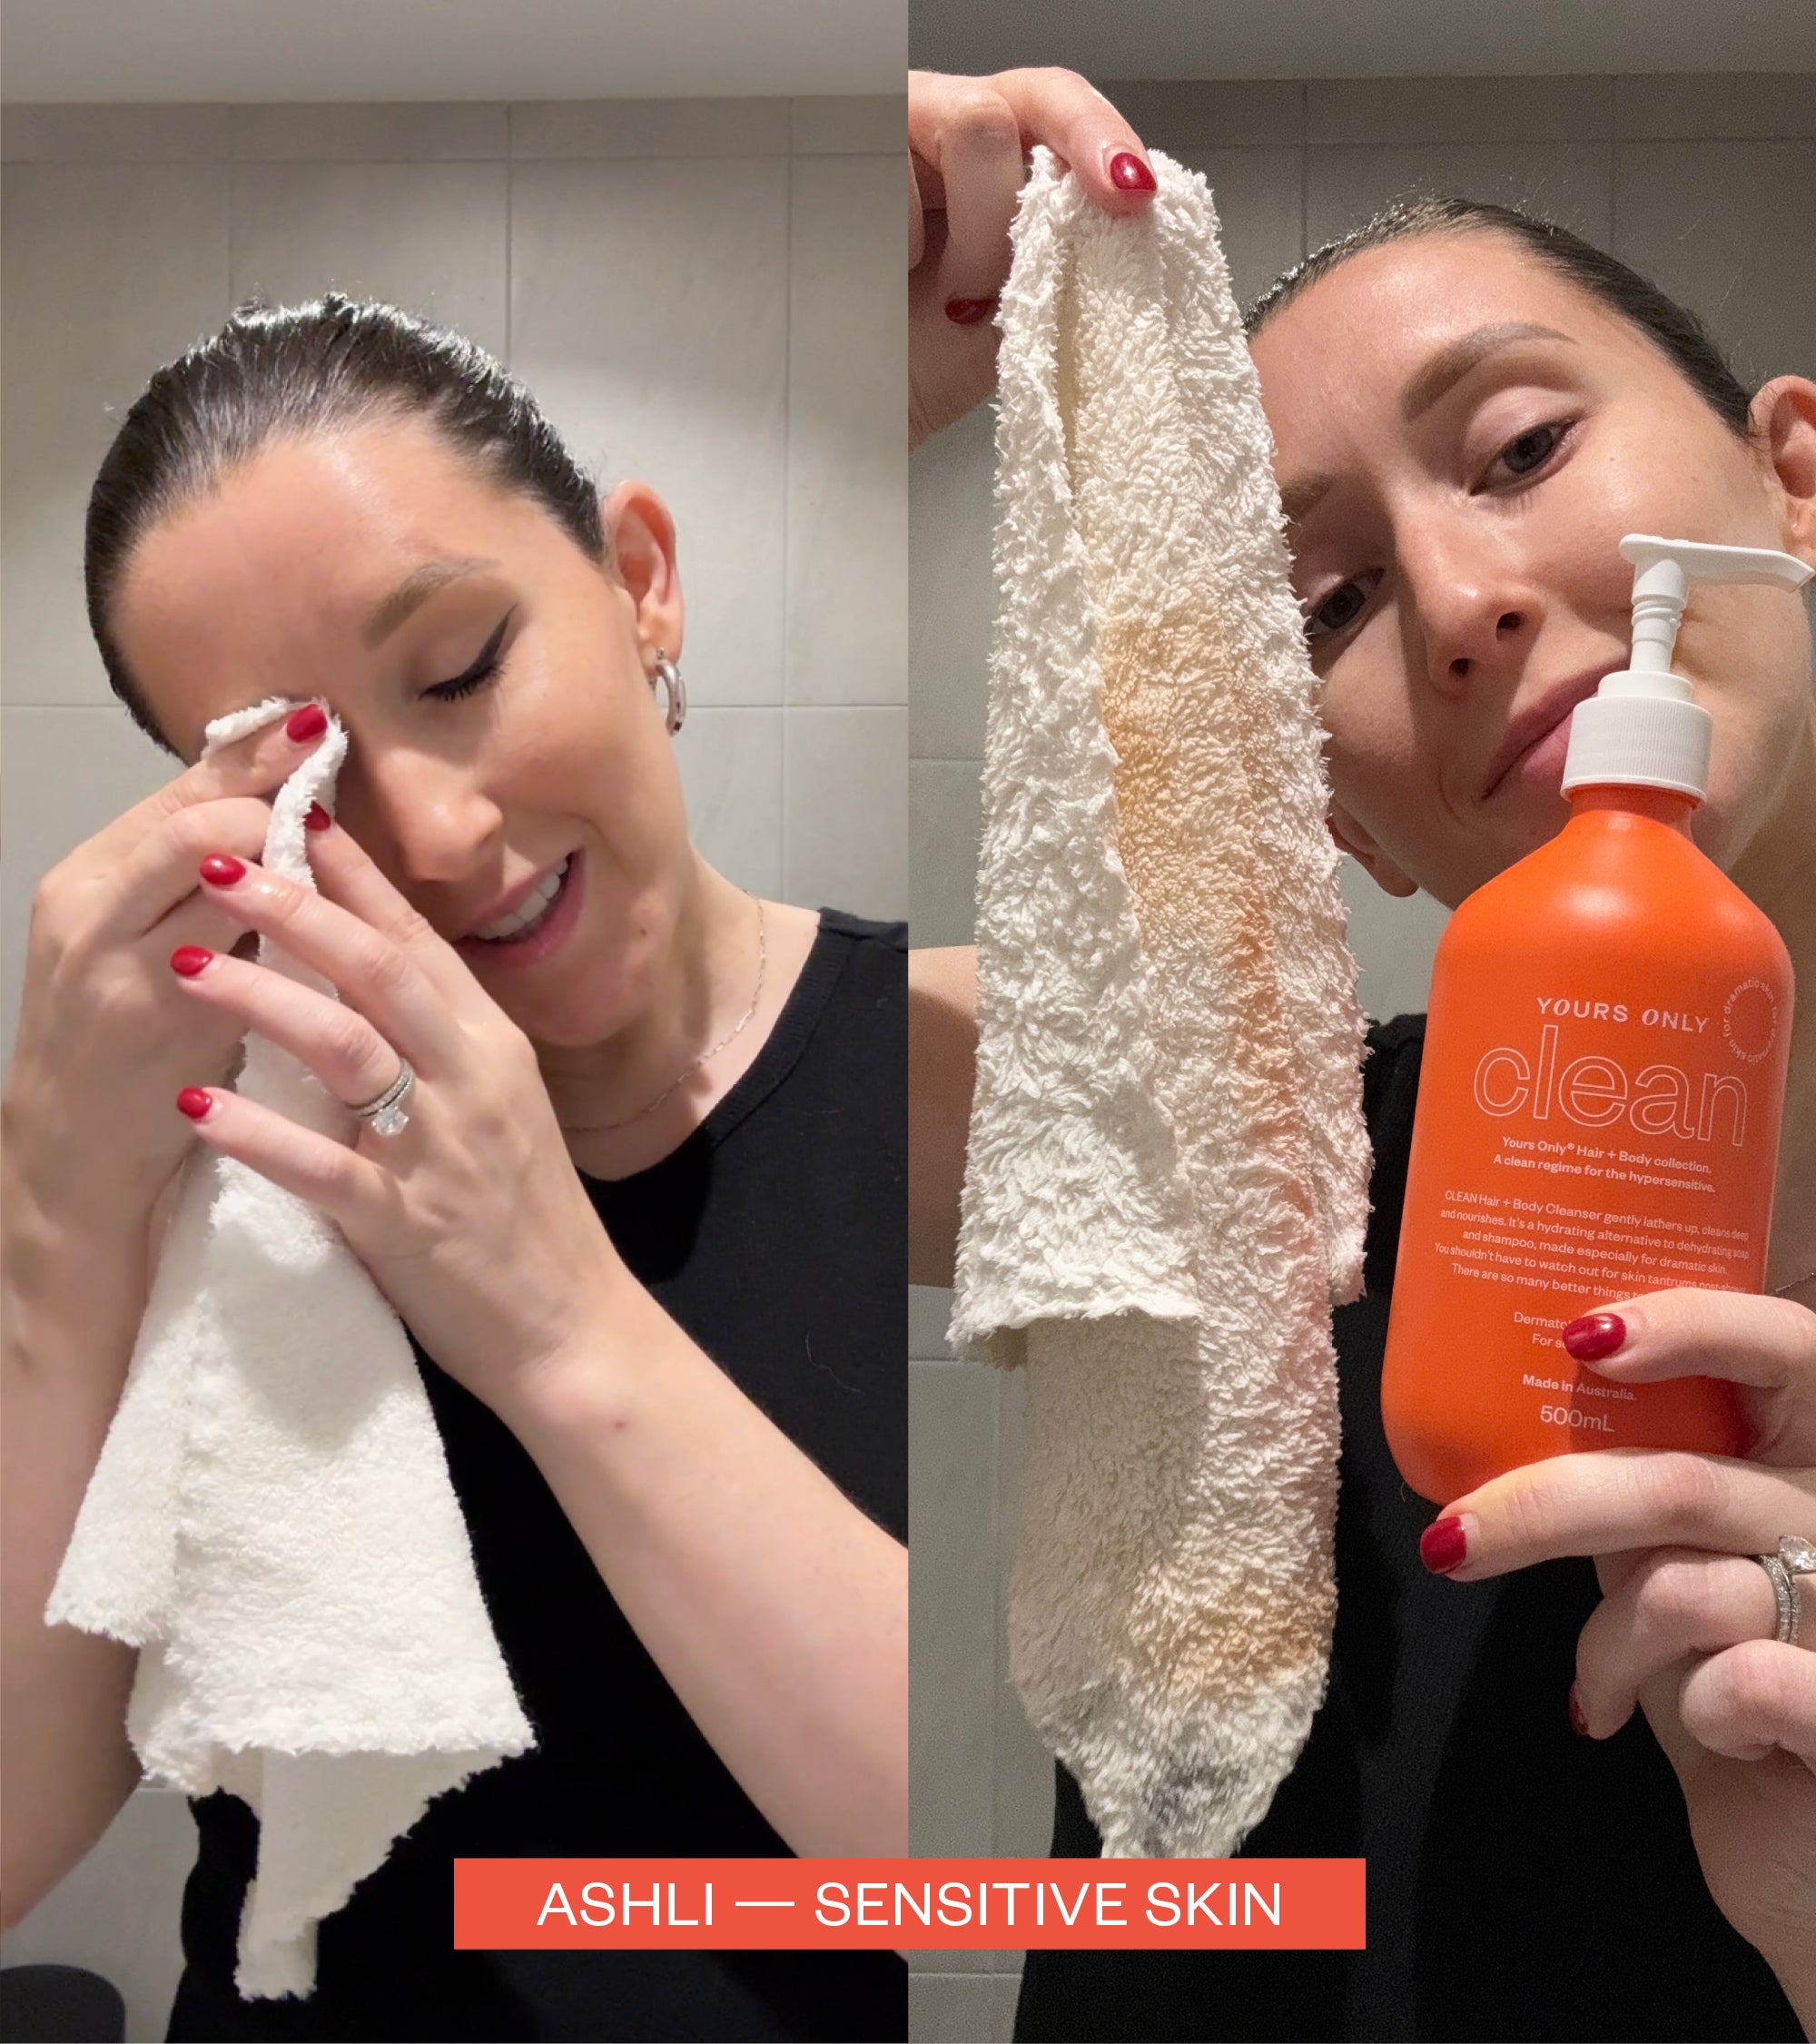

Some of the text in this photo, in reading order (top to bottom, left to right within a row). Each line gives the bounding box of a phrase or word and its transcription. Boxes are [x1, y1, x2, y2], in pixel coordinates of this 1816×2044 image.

[1536, 997, 1710, 1033] YOURS ONLY
[1474, 1023, 1747, 1147] clean
[1493, 1153, 1716, 1193] A clean regime for the hypersensitive.
[1502, 1136, 1535, 1151] Yours
[1576, 1145, 1605, 1159] Hair
[1607, 1150, 1616, 1159] +
[1618, 1150, 1652, 1168] Body
[1653, 1156, 1712, 1174] collection.
[1445, 1190, 1477, 1204] CLEAN
[1478, 1194, 1500, 1208] Hair
[1502, 1199, 1511, 1208] +
[1513, 1198, 1544, 1215] Body
[1545, 1202, 1603, 1220] Cleanser
[1604, 1212, 1642, 1227] gently
[1643, 1216, 1683, 1231] lathers
[1702, 1225, 1731, 1239] cleans
[1440, 1209, 1456, 1219] and
[1456, 1210, 1507, 1227] nourishes.
[1527, 1221, 1535, 1230] a
[1537, 1220, 1595, 1241] hydrating
[1597, 1229, 1662, 1248] alternative
[1663, 1239, 1675, 1249] to
[1677, 1239, 1732, 1260] dehydrating
[1463, 1230, 1727, 1275] and shampoo, made especially for dramatic skin.
[1435, 1241, 1449, 1255] You
[1495, 1251, 1522, 1266] have
[1525, 1257, 1536, 1268] to
[1539, 1259, 1576, 1274] watch
[1578, 1265, 1599, 1277] out
[1602, 1267, 1619, 1279] for
[1621, 1270, 1646, 1283] skin
[1647, 1274, 1697, 1289] tantrums
[1452, 1263, 1480, 1278] There
[1481, 1270, 1499, 1280] are
[1501, 1273, 1515, 1283] so
[1515, 1276, 1549, 1291] many
[1552, 1279, 1591, 1296] better
[1593, 1285, 1631, 1301] things
[1513, 1311, 1572, 1329] Dermato
[1532, 1333, 1553, 1347] For
[1522, 1373, 1638, 1401] Made in Australia.
[1539, 1404, 1615, 1432] 500mL
